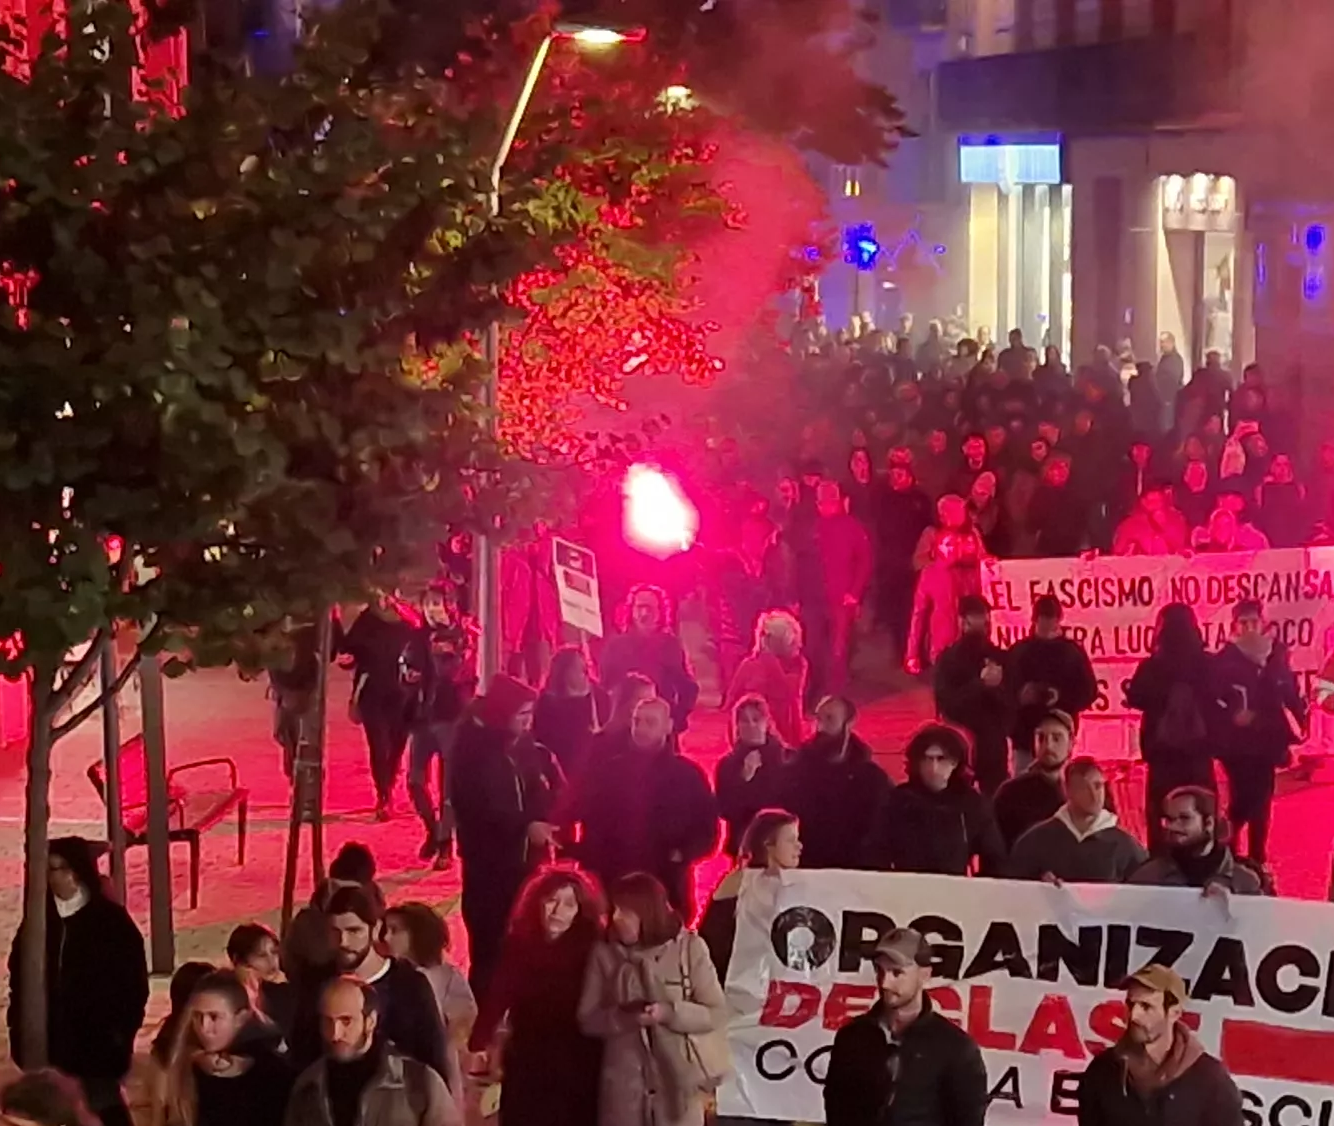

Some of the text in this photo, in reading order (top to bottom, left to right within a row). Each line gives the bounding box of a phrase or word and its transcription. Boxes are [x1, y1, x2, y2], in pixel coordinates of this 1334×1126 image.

[989, 569, 1334, 611] EL FASCISMO NO DESCANSA
